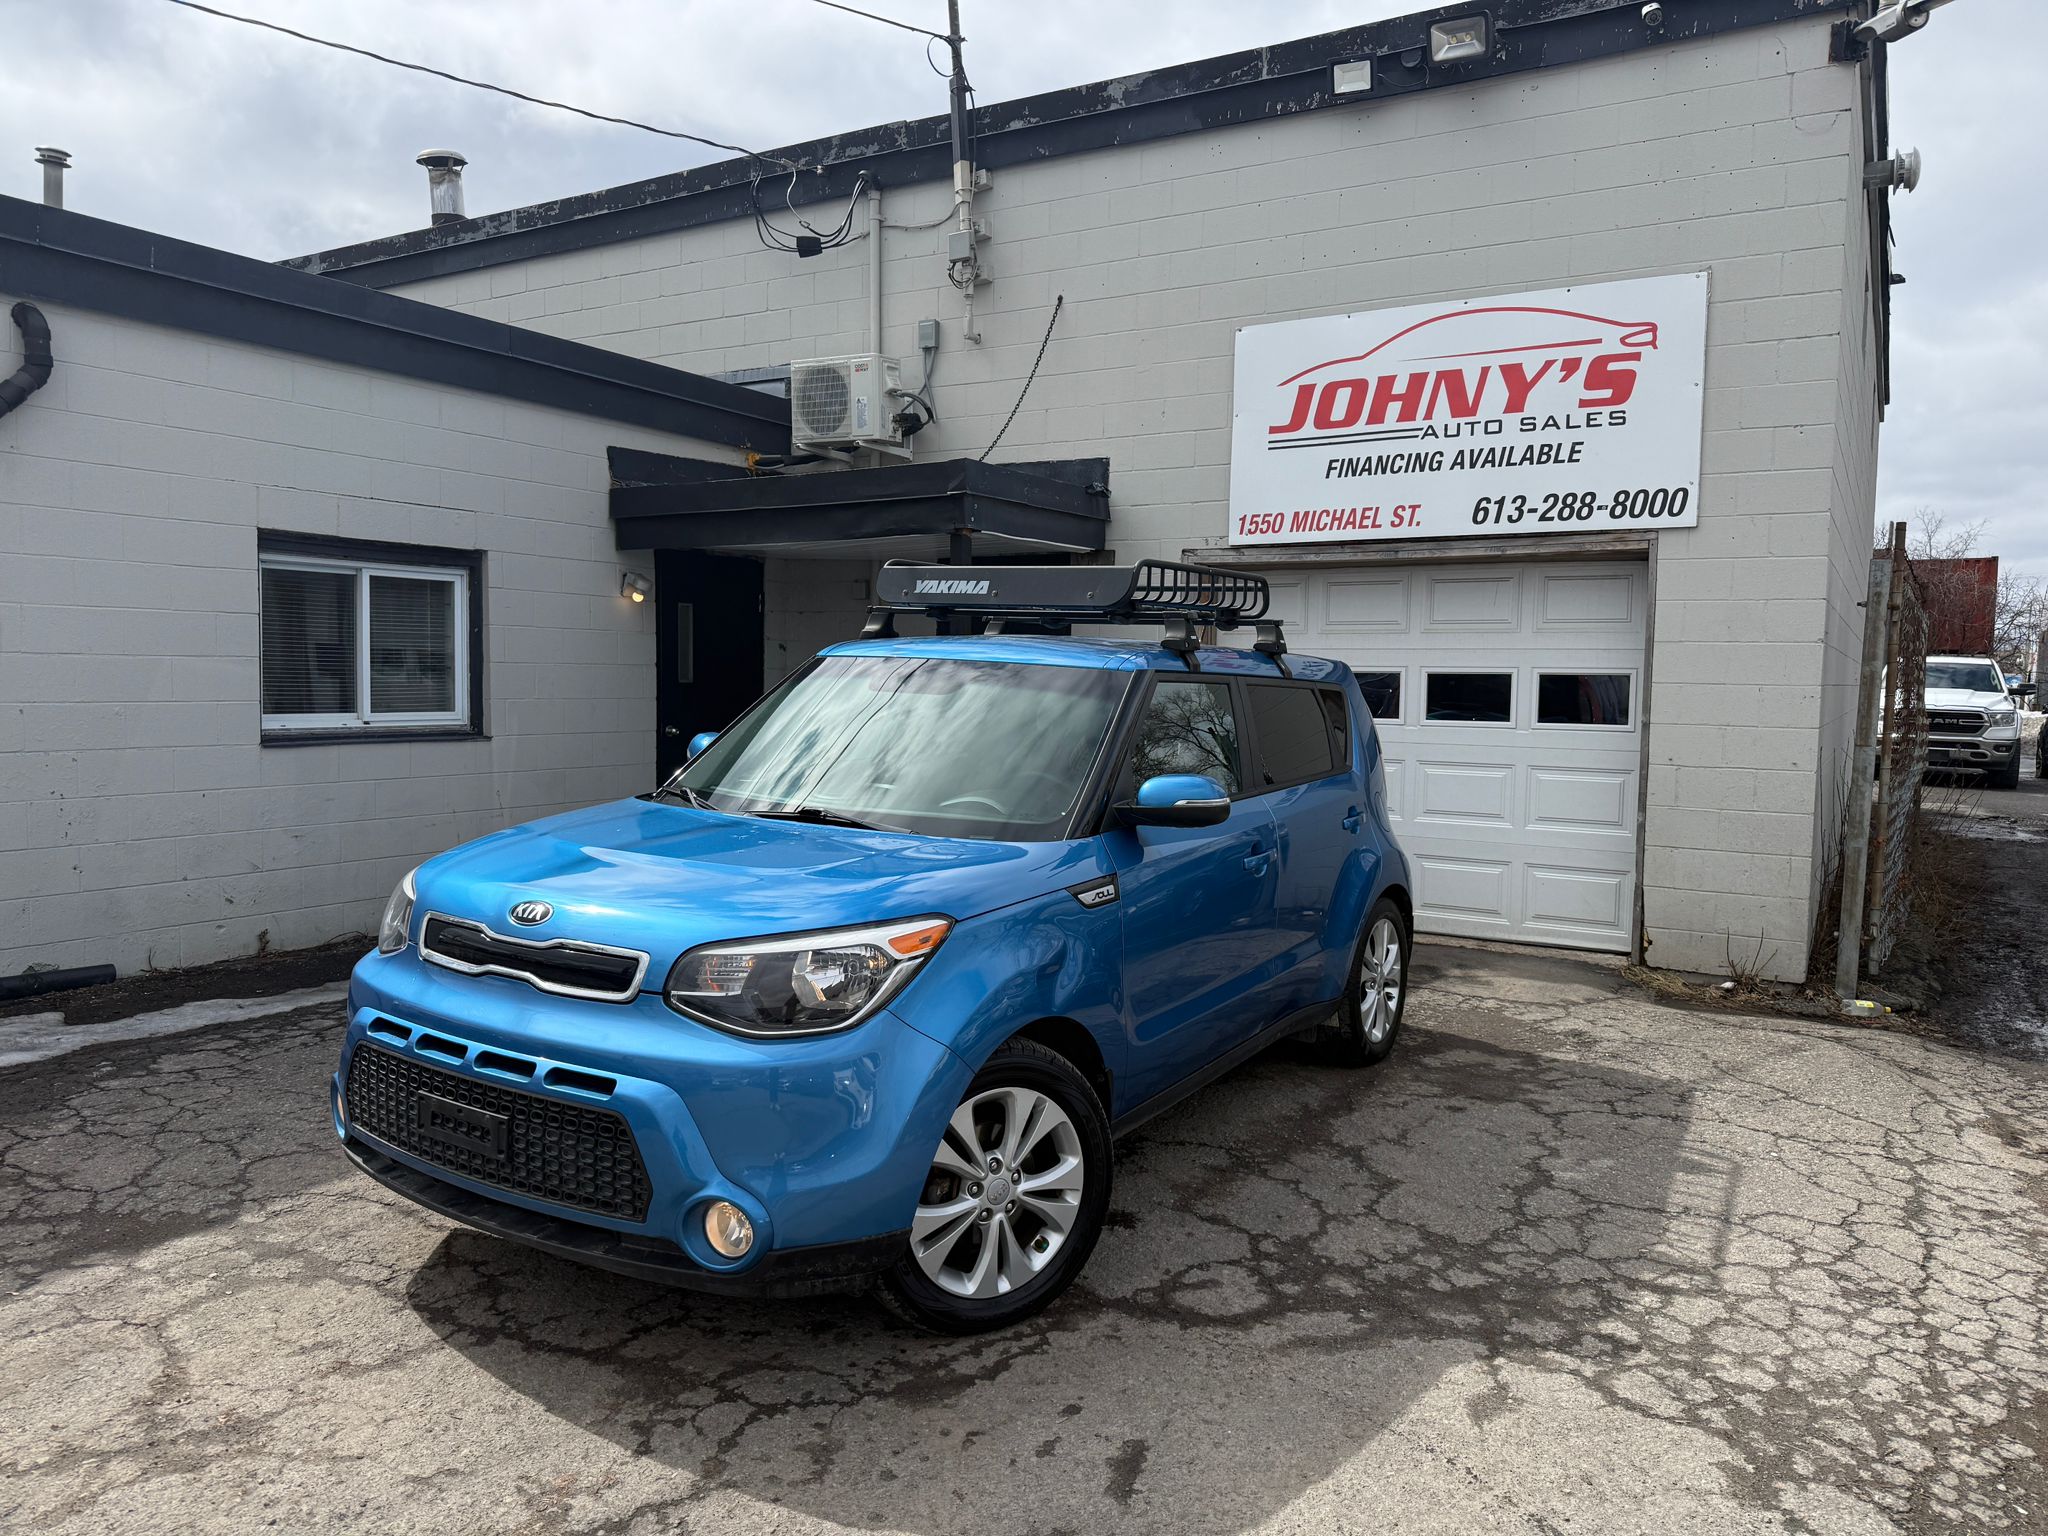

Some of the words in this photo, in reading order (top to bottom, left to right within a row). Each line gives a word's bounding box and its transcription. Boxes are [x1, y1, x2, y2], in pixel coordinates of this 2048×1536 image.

[1268, 352, 1642, 434] JOHNY'S
[1421, 418, 1503, 440] AUTO
[1519, 410, 1627, 432] SALES
[1325, 451, 1444, 479] FINANCING
[1449, 441, 1585, 471] AVAILABLE
[1238, 512, 1285, 536] 1550
[1289, 507, 1382, 533] MICHAEL
[1390, 504, 1422, 528] ST.
[1472, 487, 1689, 526] 613-288-8000
[914, 579, 990, 594] YAKIMA
[513, 903, 545, 920] KIA
